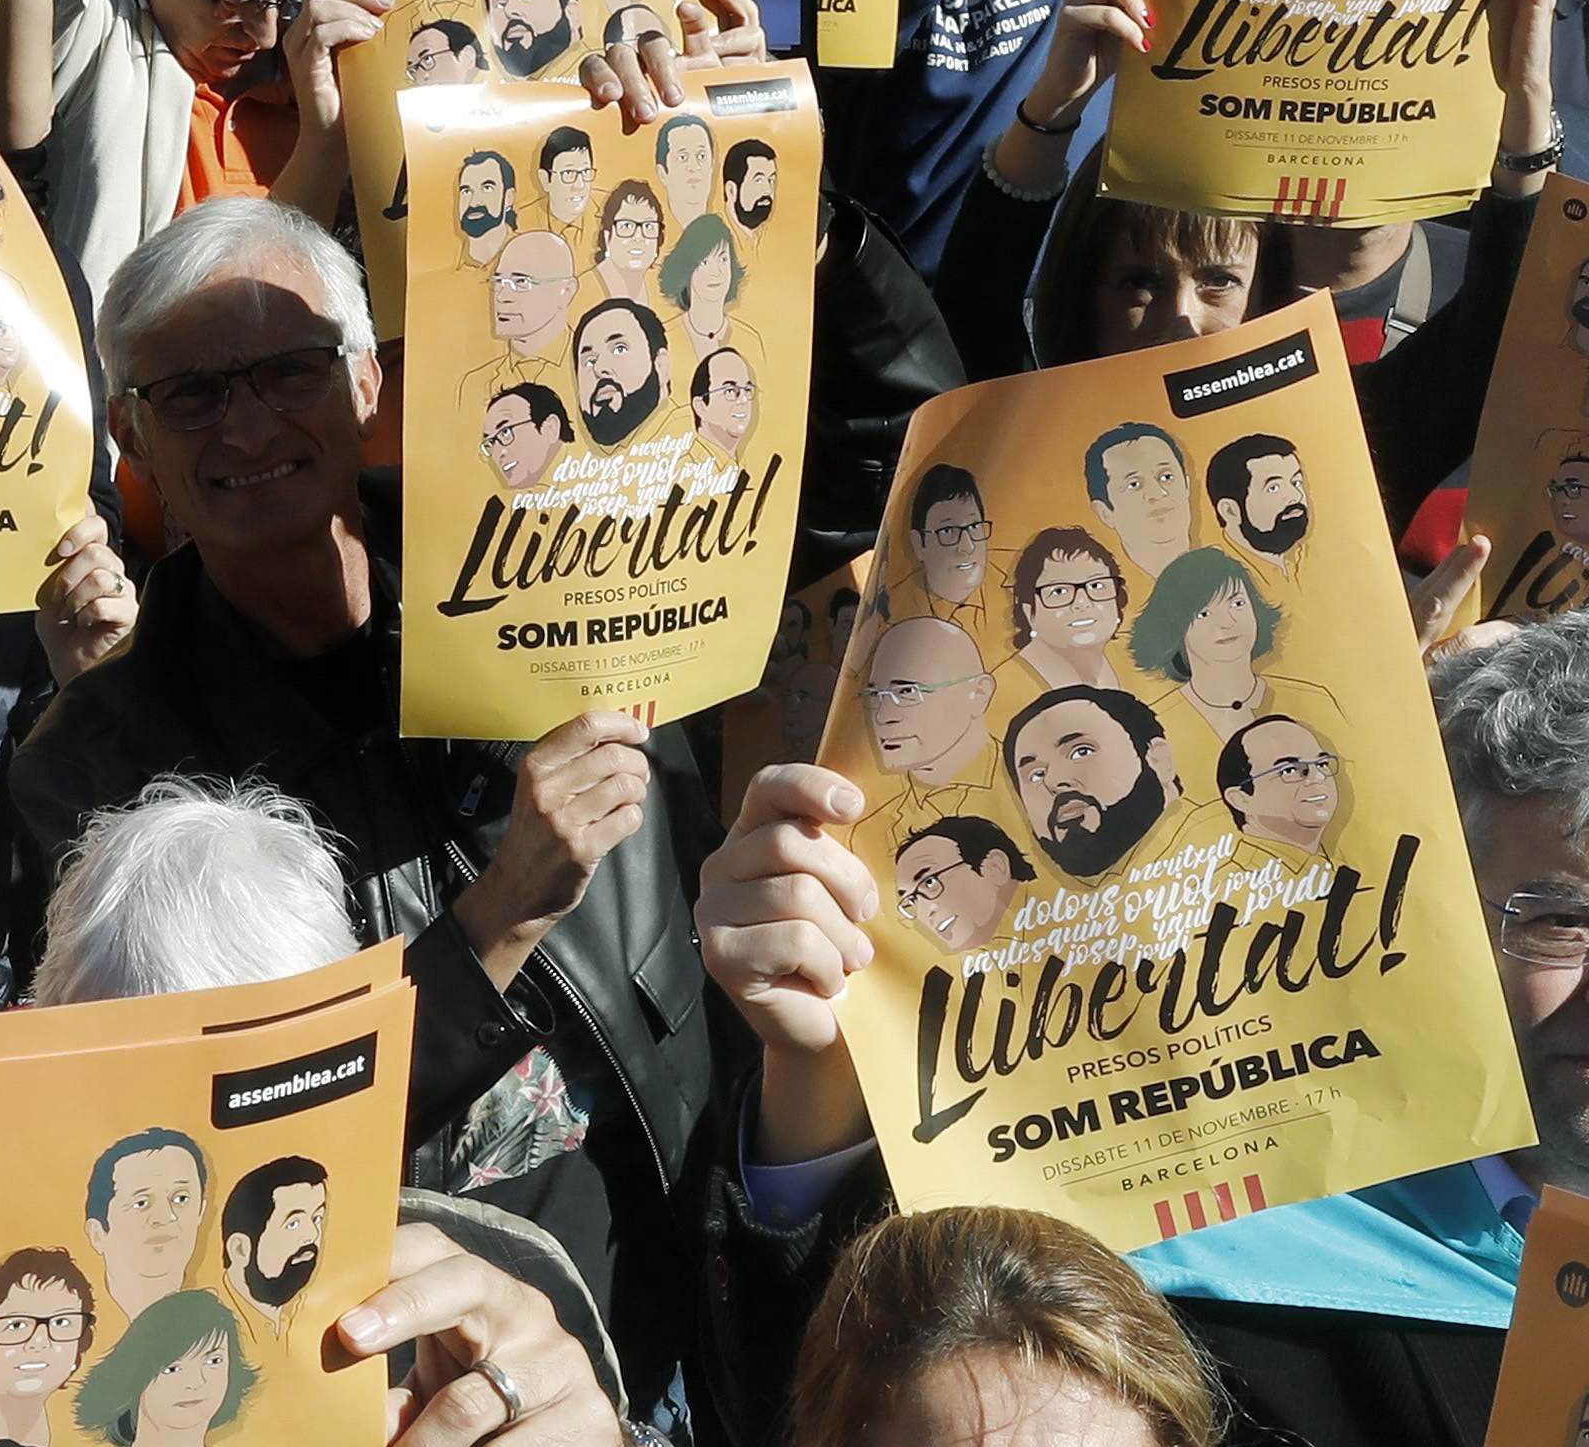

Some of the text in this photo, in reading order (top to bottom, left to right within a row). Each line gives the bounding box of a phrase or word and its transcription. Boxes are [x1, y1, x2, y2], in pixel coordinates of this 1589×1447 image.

[1199, 94, 1436, 124] SOM REPÚBLICA
[1181, 346, 1306, 402] assemblea.cat
[437, 455, 782, 617] Llibertat!
[913, 834, 1419, 1144] Llibertat!
[228, 1053, 366, 1109] assemblea.cat
[1066, 1013, 1273, 1085] PRESOS POLÍTICS
[987, 1027, 1382, 1164] SOM REPÚBLICA
[1121, 1134, 1280, 1193] BARCELONA
